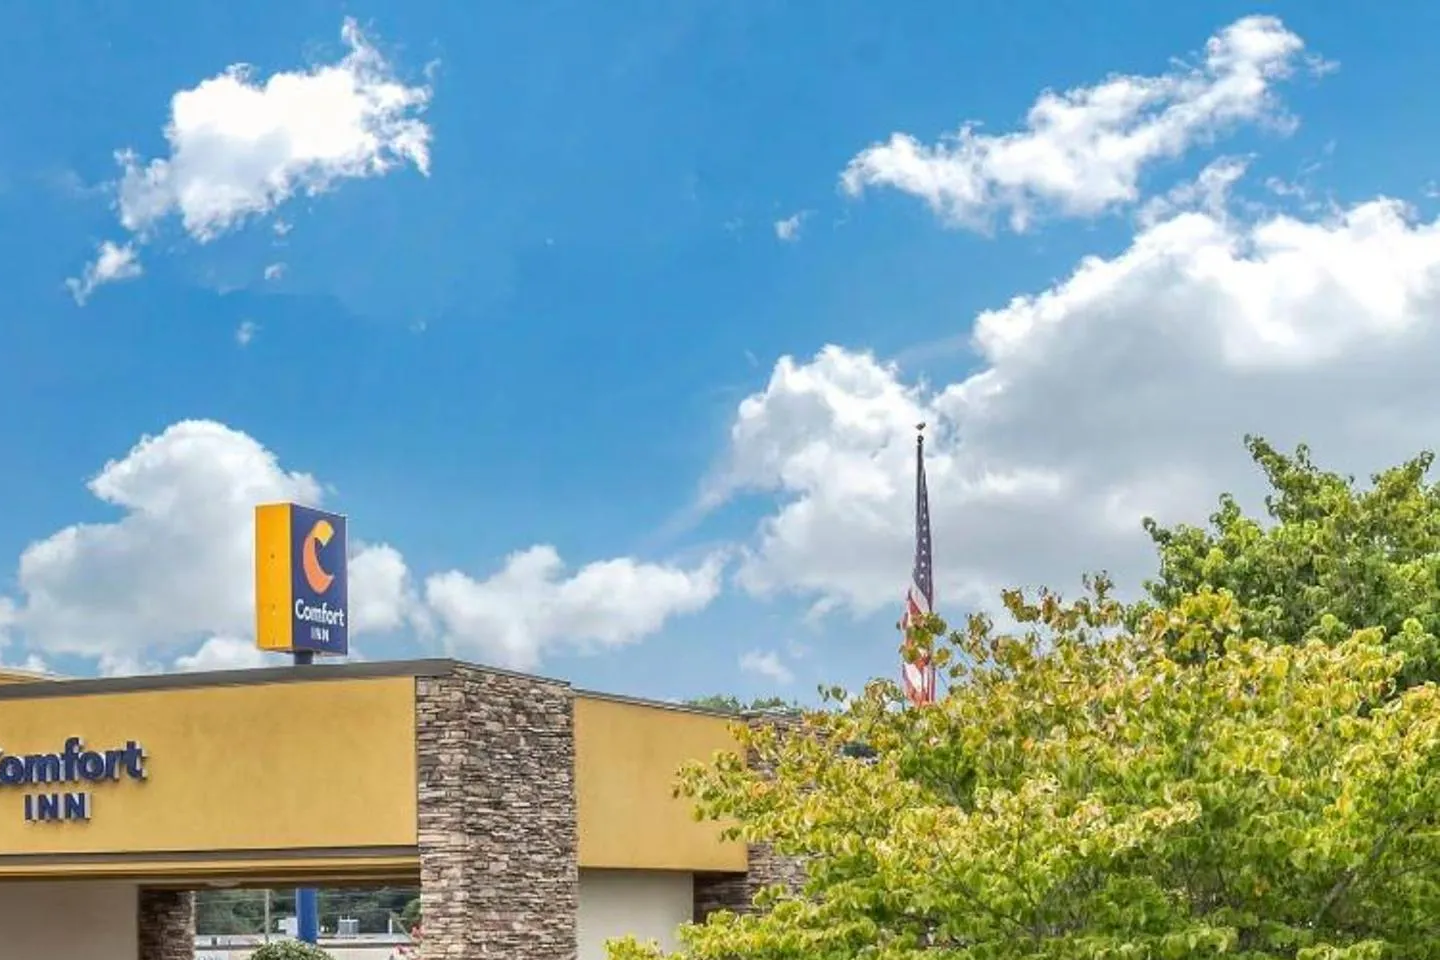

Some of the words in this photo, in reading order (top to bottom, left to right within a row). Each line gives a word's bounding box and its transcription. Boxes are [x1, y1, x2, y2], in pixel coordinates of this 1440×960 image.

[295, 599, 344, 627] Comfort
[311, 627, 329, 642] INN
[24, 793, 91, 821] INN
